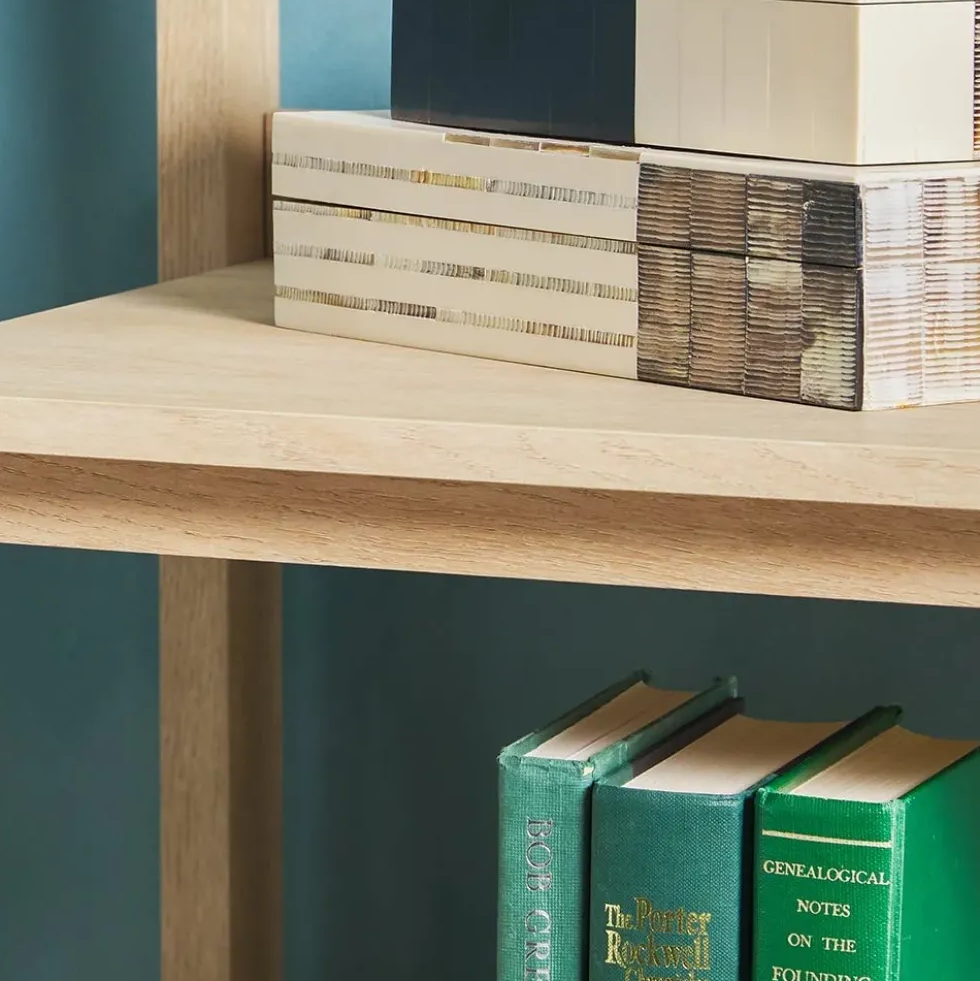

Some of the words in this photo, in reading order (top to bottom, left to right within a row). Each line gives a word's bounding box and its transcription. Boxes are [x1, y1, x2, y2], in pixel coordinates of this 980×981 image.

[526, 818, 552, 891] BOB
[763, 860, 891, 885] GENEALOGICAL
[604, 903, 633, 930] The
[633, 897, 711, 935] Porter
[797, 899, 851, 917] NOTES
[605, 929, 711, 970] Rockwell
[788, 933, 812, 948] ON
[822, 937, 857, 953] THE
